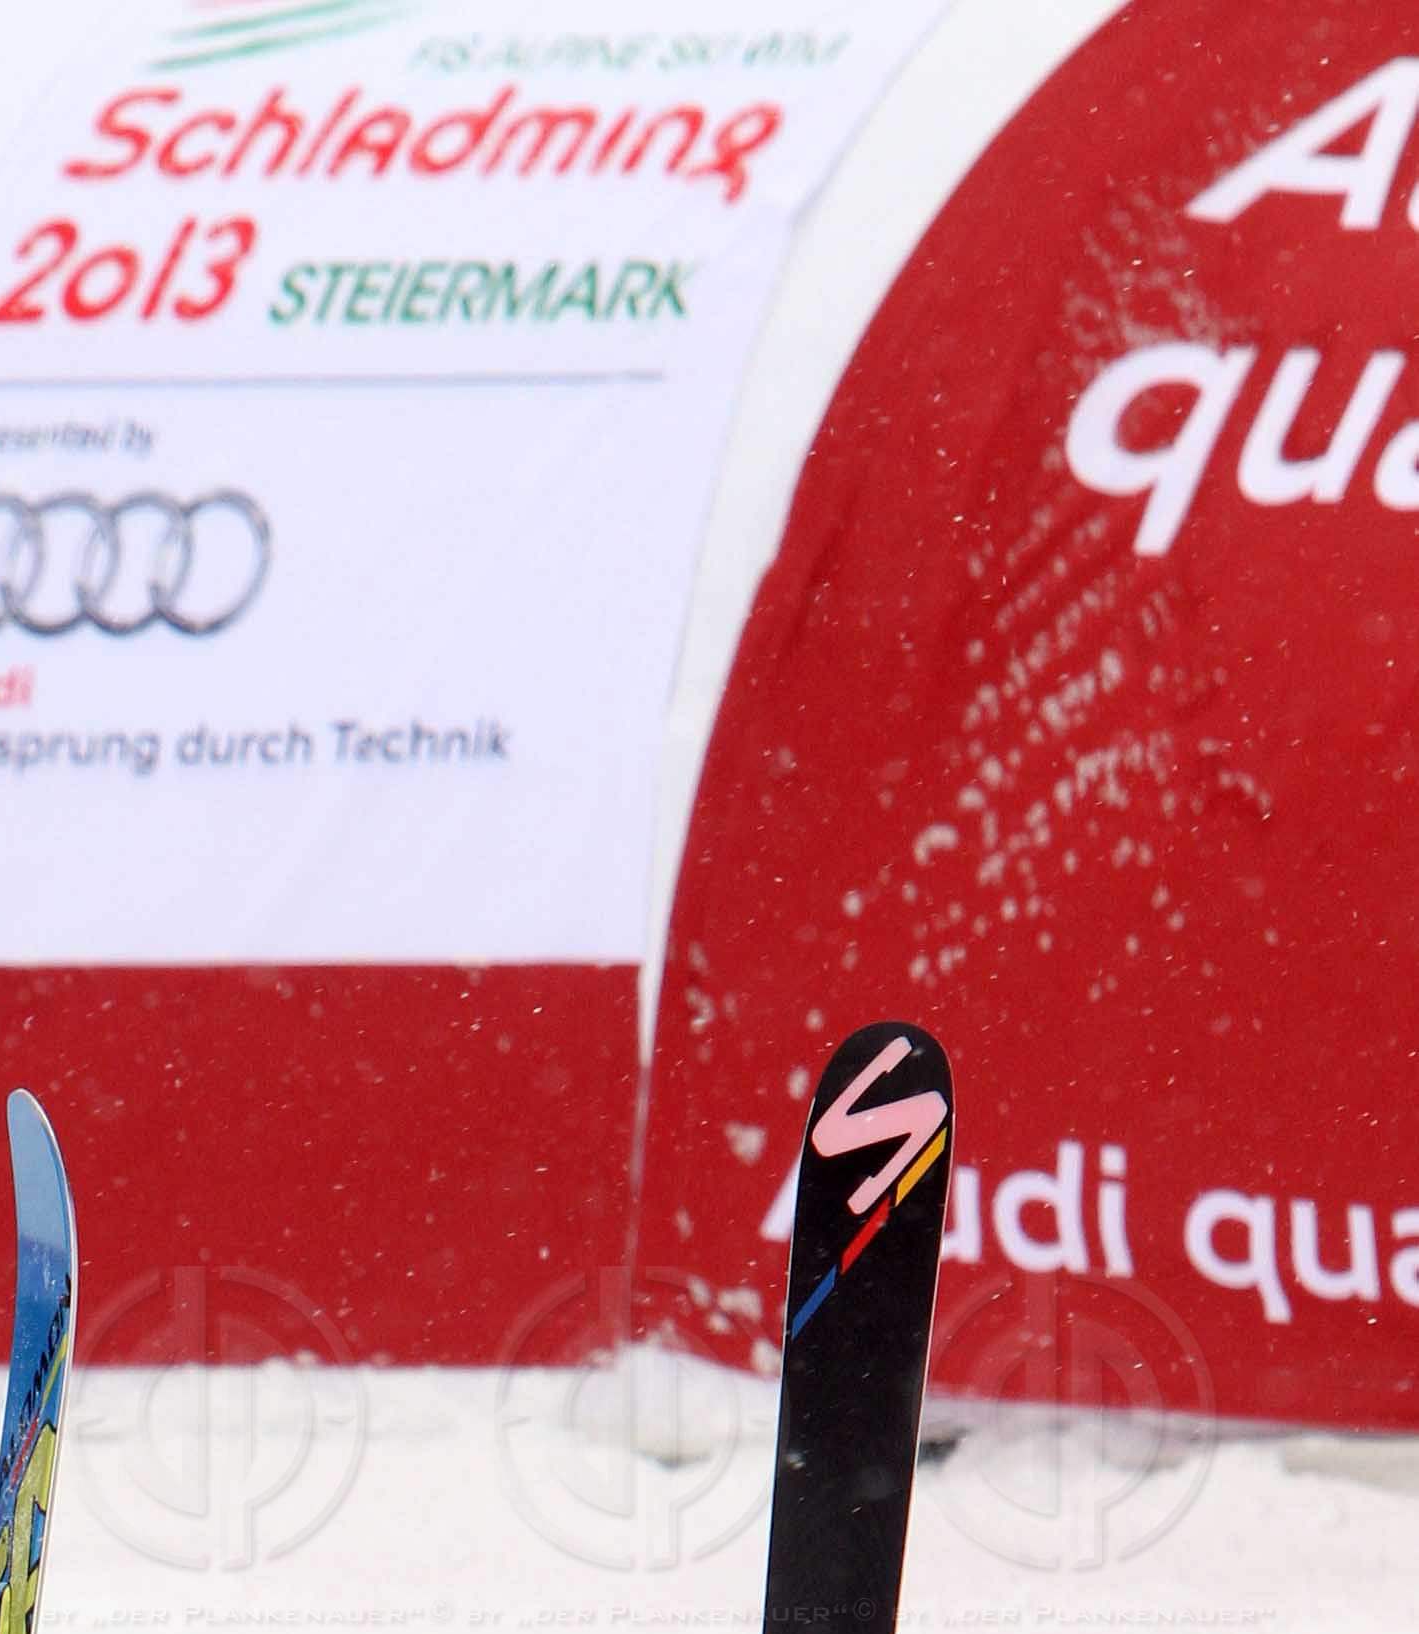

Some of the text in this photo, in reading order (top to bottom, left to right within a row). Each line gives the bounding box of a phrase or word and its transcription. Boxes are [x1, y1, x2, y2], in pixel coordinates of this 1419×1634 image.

[63, 85, 783, 205] Schladming
[267, 260, 696, 326] STEIERMARK
[123, 418, 156, 460] by
[177, 722, 314, 765] durch
[329, 719, 511, 764] Technik
